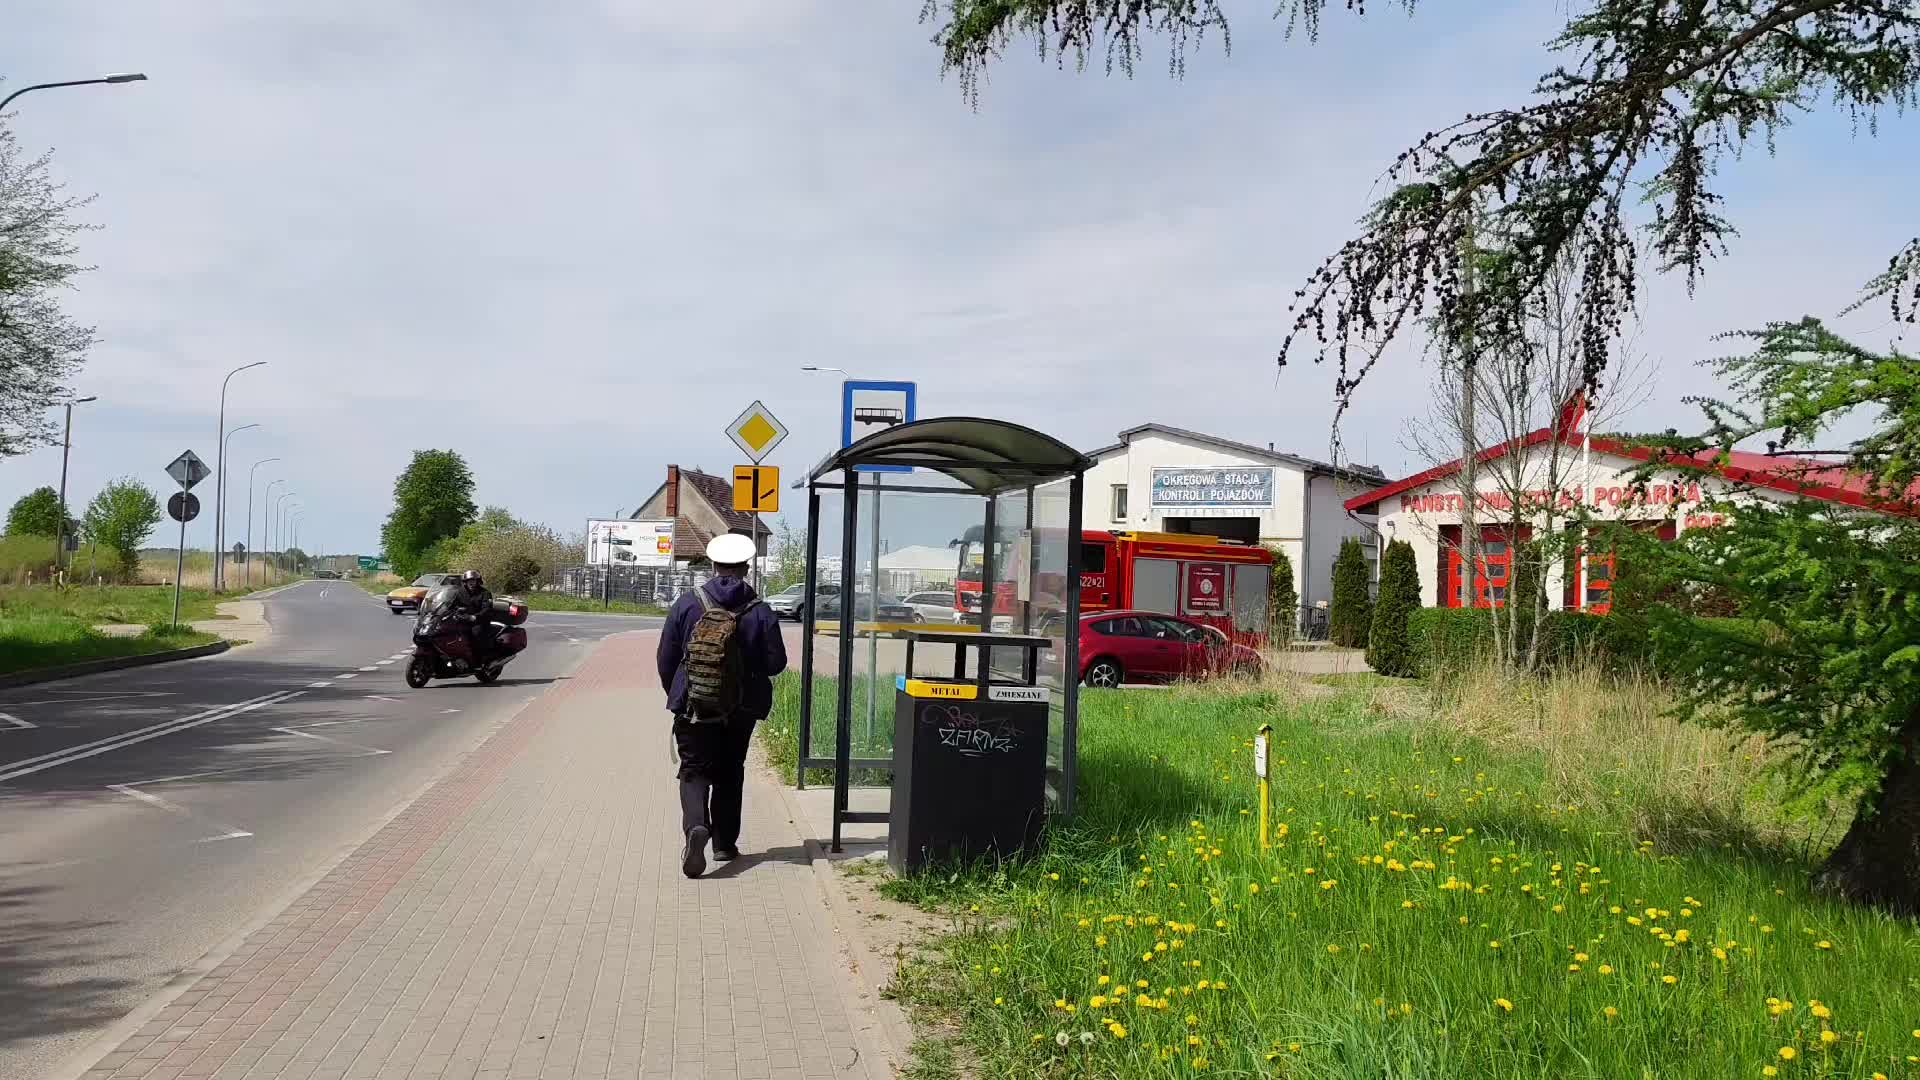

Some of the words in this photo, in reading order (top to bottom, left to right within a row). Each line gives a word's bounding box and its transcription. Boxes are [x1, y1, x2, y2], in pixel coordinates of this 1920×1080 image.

[1224, 473, 1260, 485] STACJA
[1158, 489, 1205, 501] KONTROLI
[1210, 487, 1264, 501] POJAZDÓW
